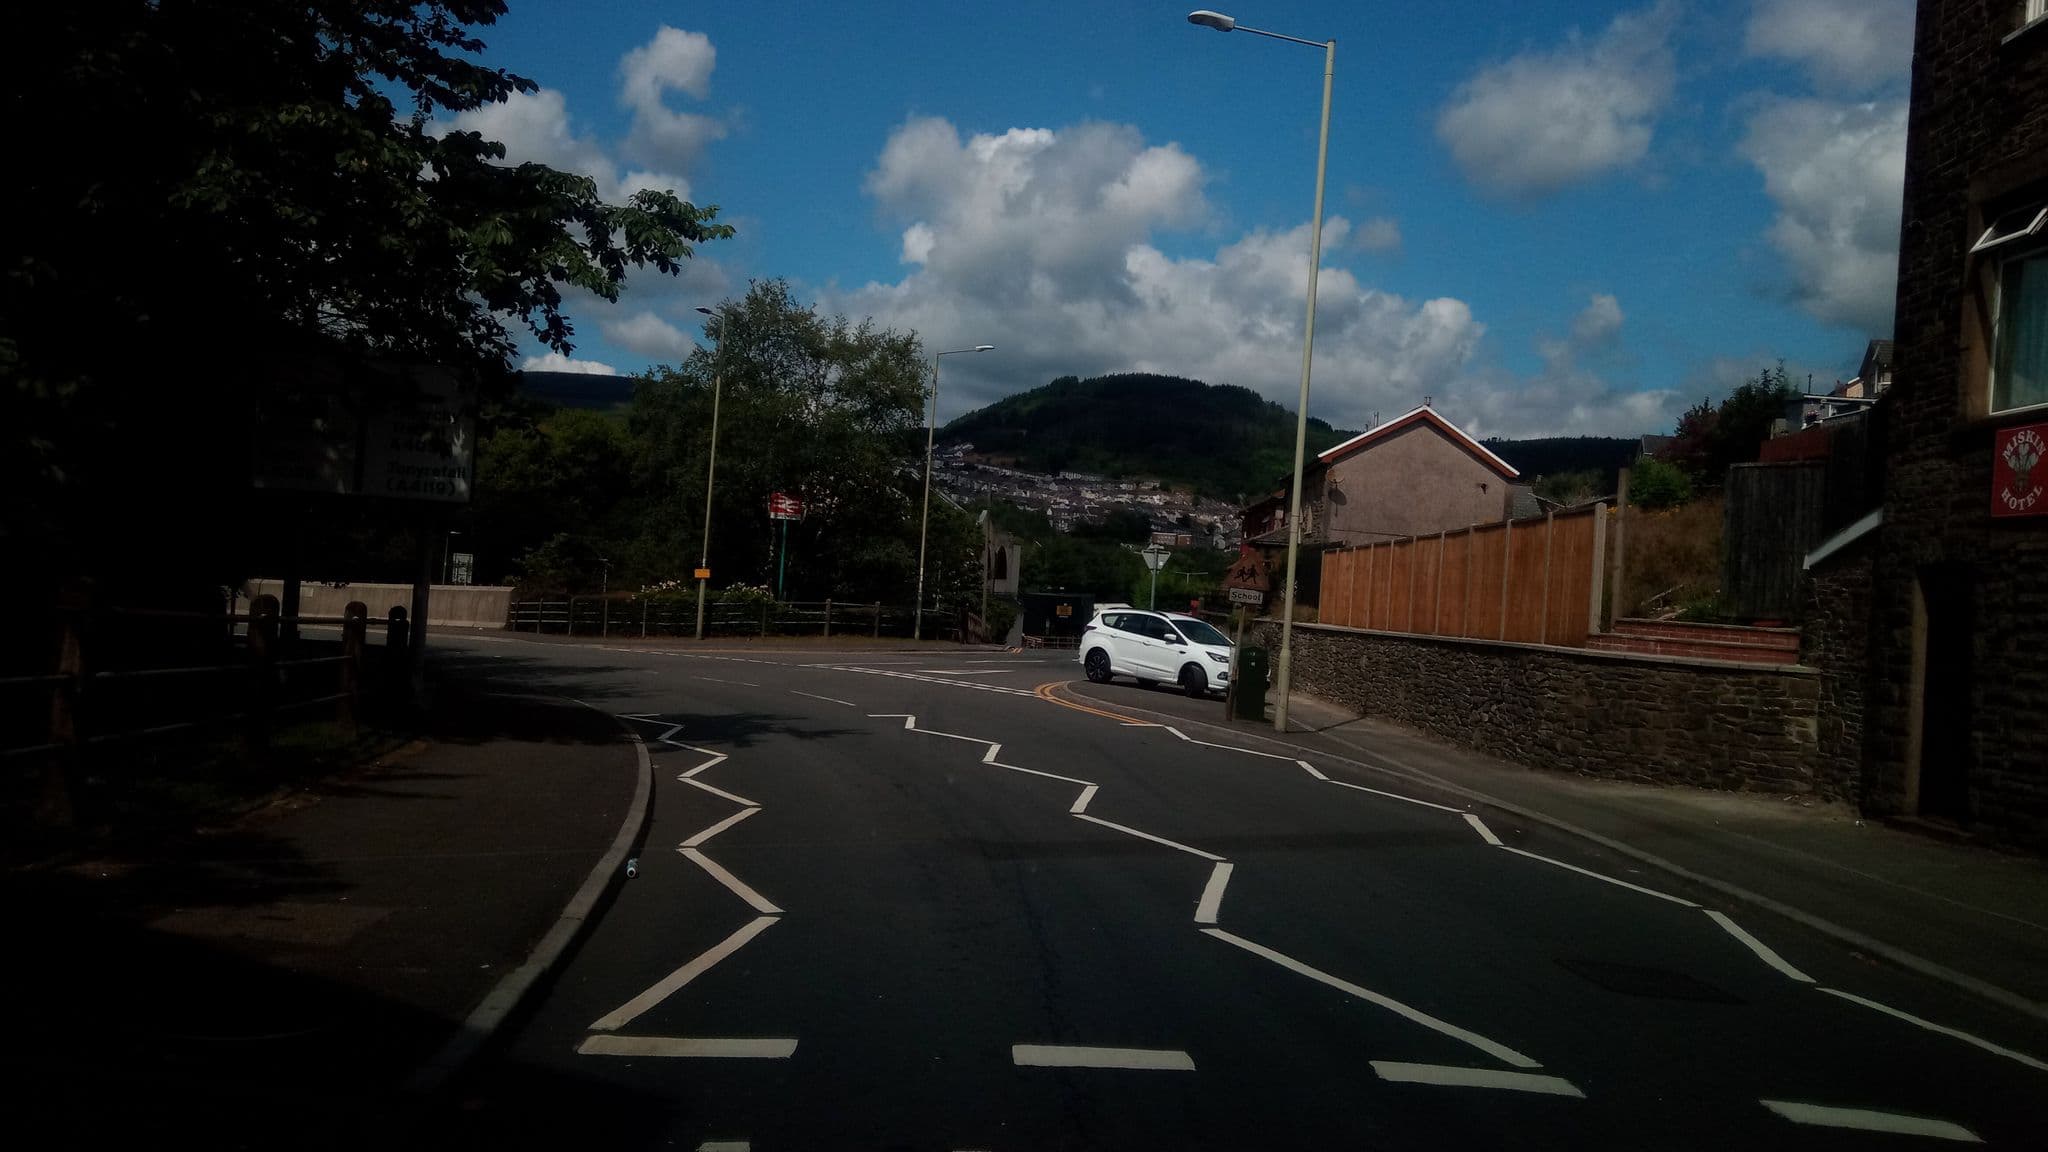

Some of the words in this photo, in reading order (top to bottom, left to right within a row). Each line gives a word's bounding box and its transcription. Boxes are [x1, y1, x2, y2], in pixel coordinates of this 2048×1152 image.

[2003, 430, 2046, 460] MISKIN
[2001, 487, 2043, 511] HOTEL
[1231, 591, 1261, 601] School
